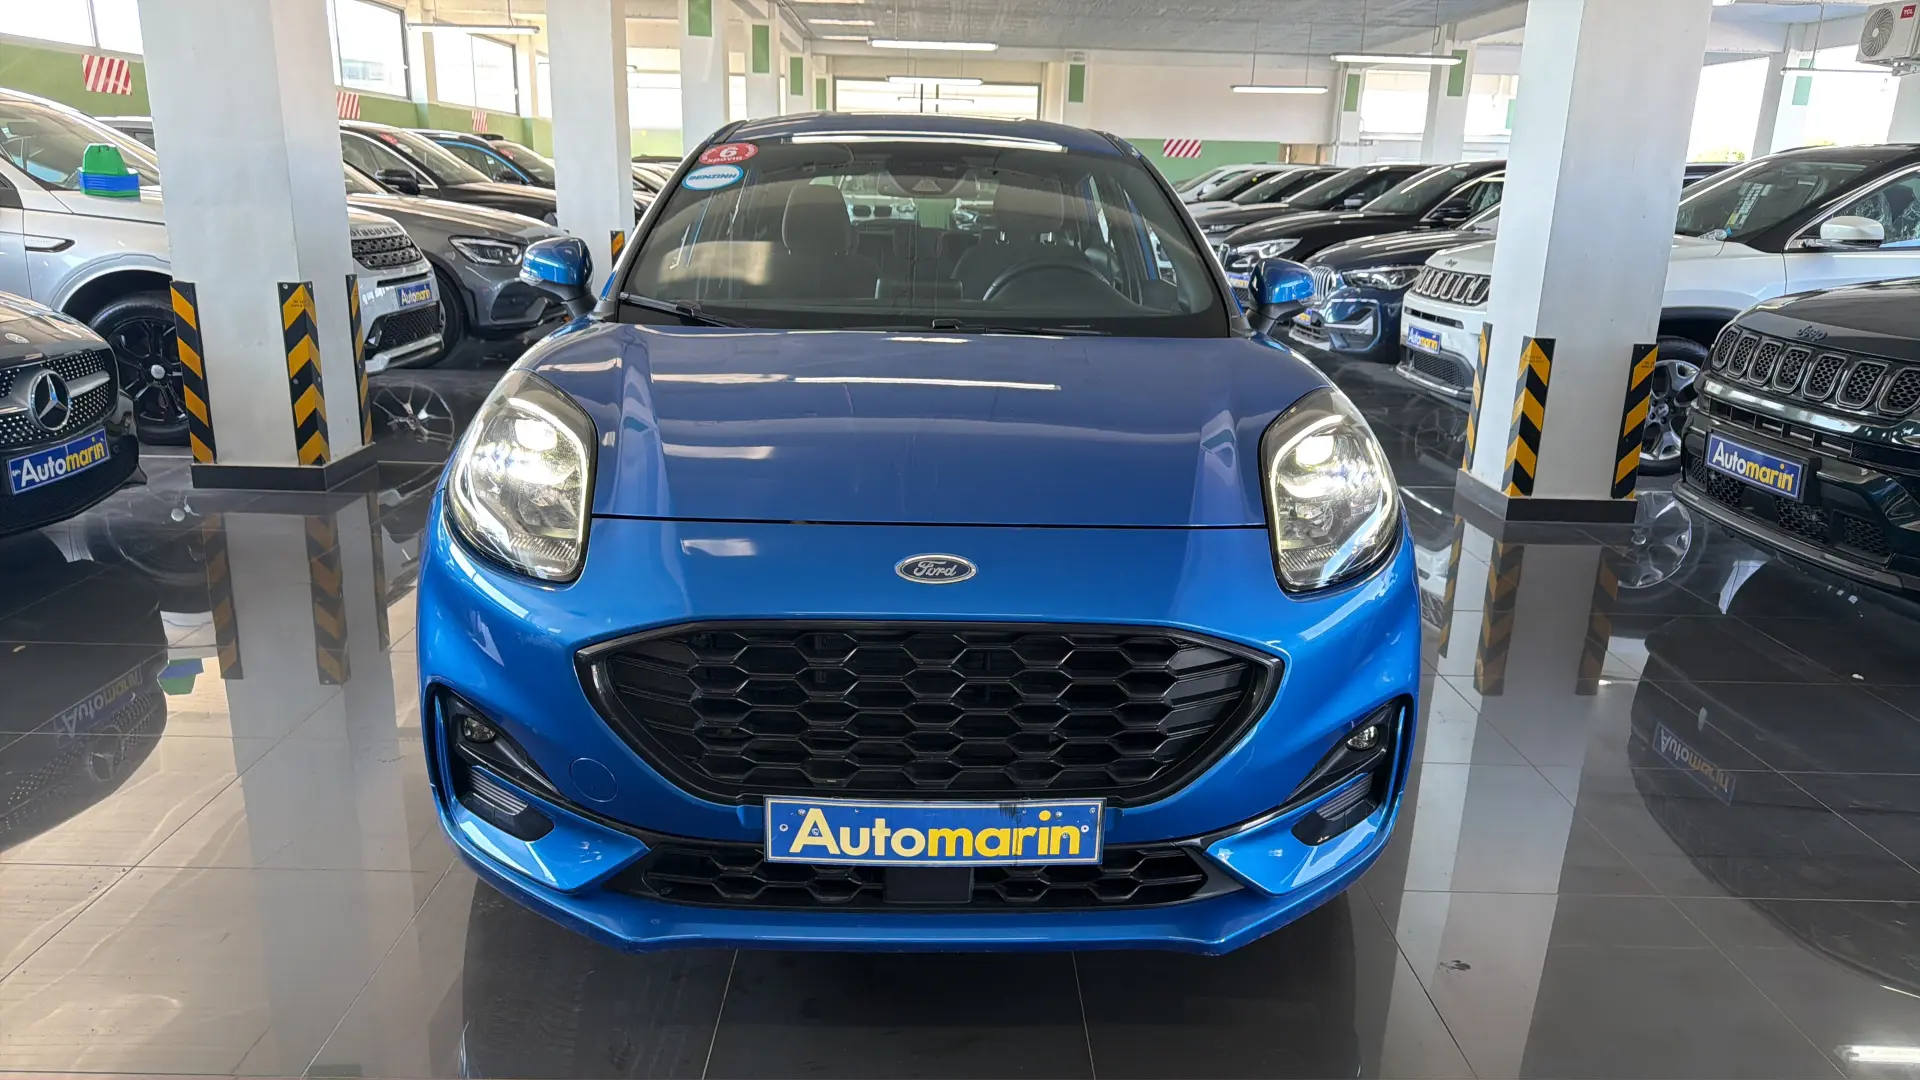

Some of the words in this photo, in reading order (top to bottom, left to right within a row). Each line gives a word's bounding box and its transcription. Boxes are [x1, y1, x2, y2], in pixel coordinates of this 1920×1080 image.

[719, 146, 738, 157] 6
[401, 284, 431, 305] Automarin
[1408, 326, 1439, 351] Automarin
[1796, 325, 1828, 342] Jeep
[21, 436, 105, 488] Automarin
[1712, 441, 1794, 491] Automarin
[913, 560, 957, 576] Ford
[789, 808, 1081, 858] Automarin
